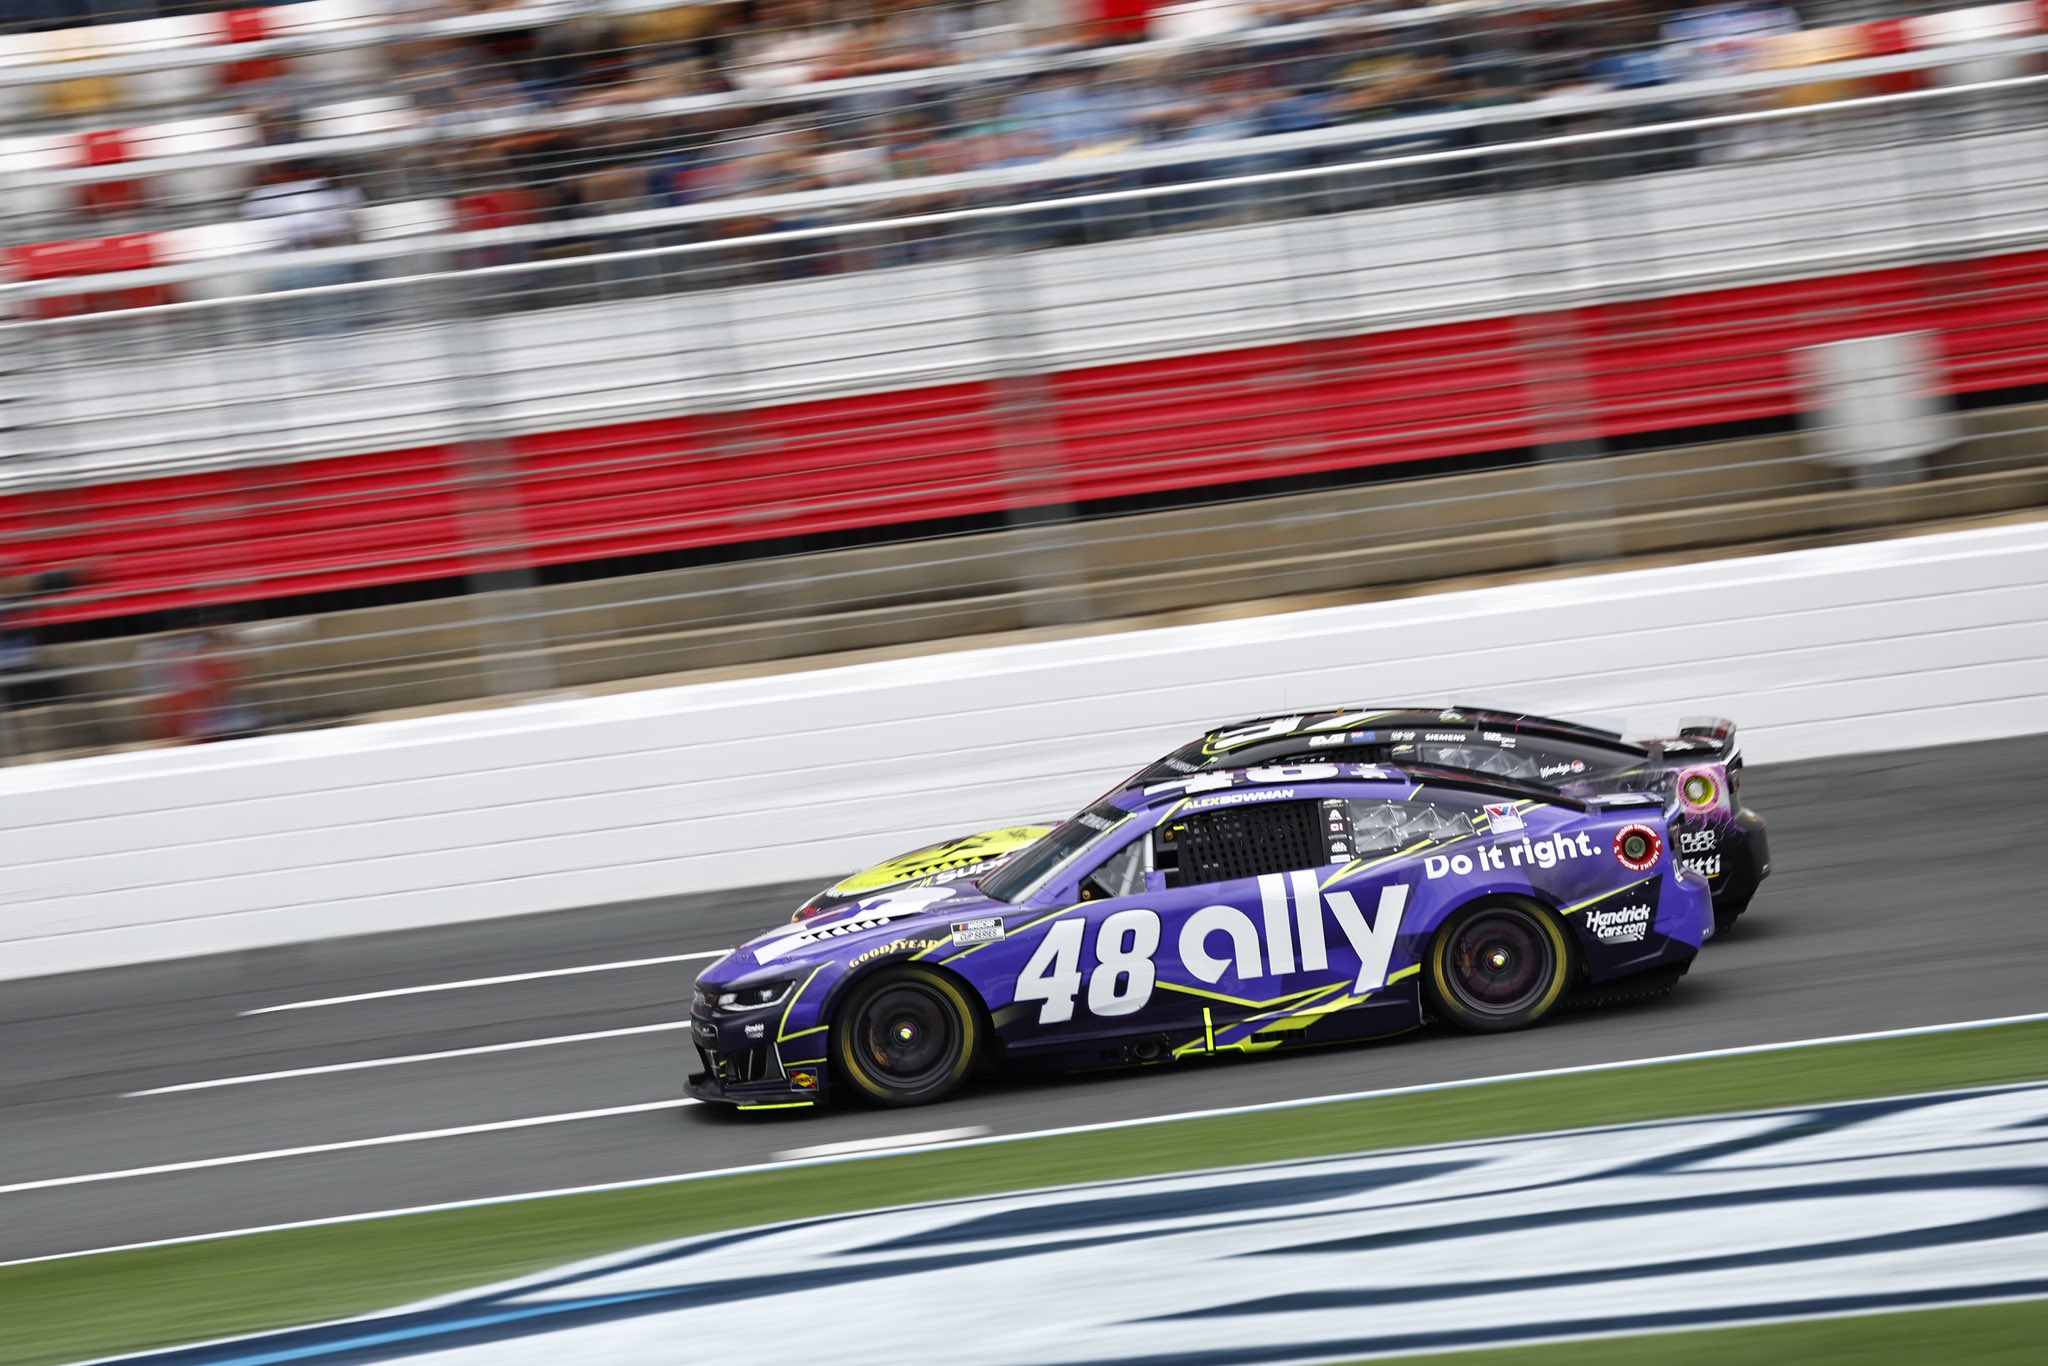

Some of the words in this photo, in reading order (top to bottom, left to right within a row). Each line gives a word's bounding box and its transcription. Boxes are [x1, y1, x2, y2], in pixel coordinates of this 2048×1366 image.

[1424, 733, 1467, 742] SIEMENS
[1680, 829, 1715, 844] QUAD
[1681, 839, 1717, 854] LOCK
[1424, 854, 1473, 880] Do
[1477, 843, 1506, 872] it
[1509, 831, 1602, 869] right.
[968, 919, 996, 931] NASCAR
[1586, 904, 1651, 932] Hendrick
[959, 931, 974, 941] CUP
[974, 929, 998, 940] SERIES
[1597, 922, 1647, 938] Cars.com
[849, 937, 940, 968] GOODYEAR
[1013, 909, 1162, 1024] 48
[1178, 869, 1409, 995] ally
